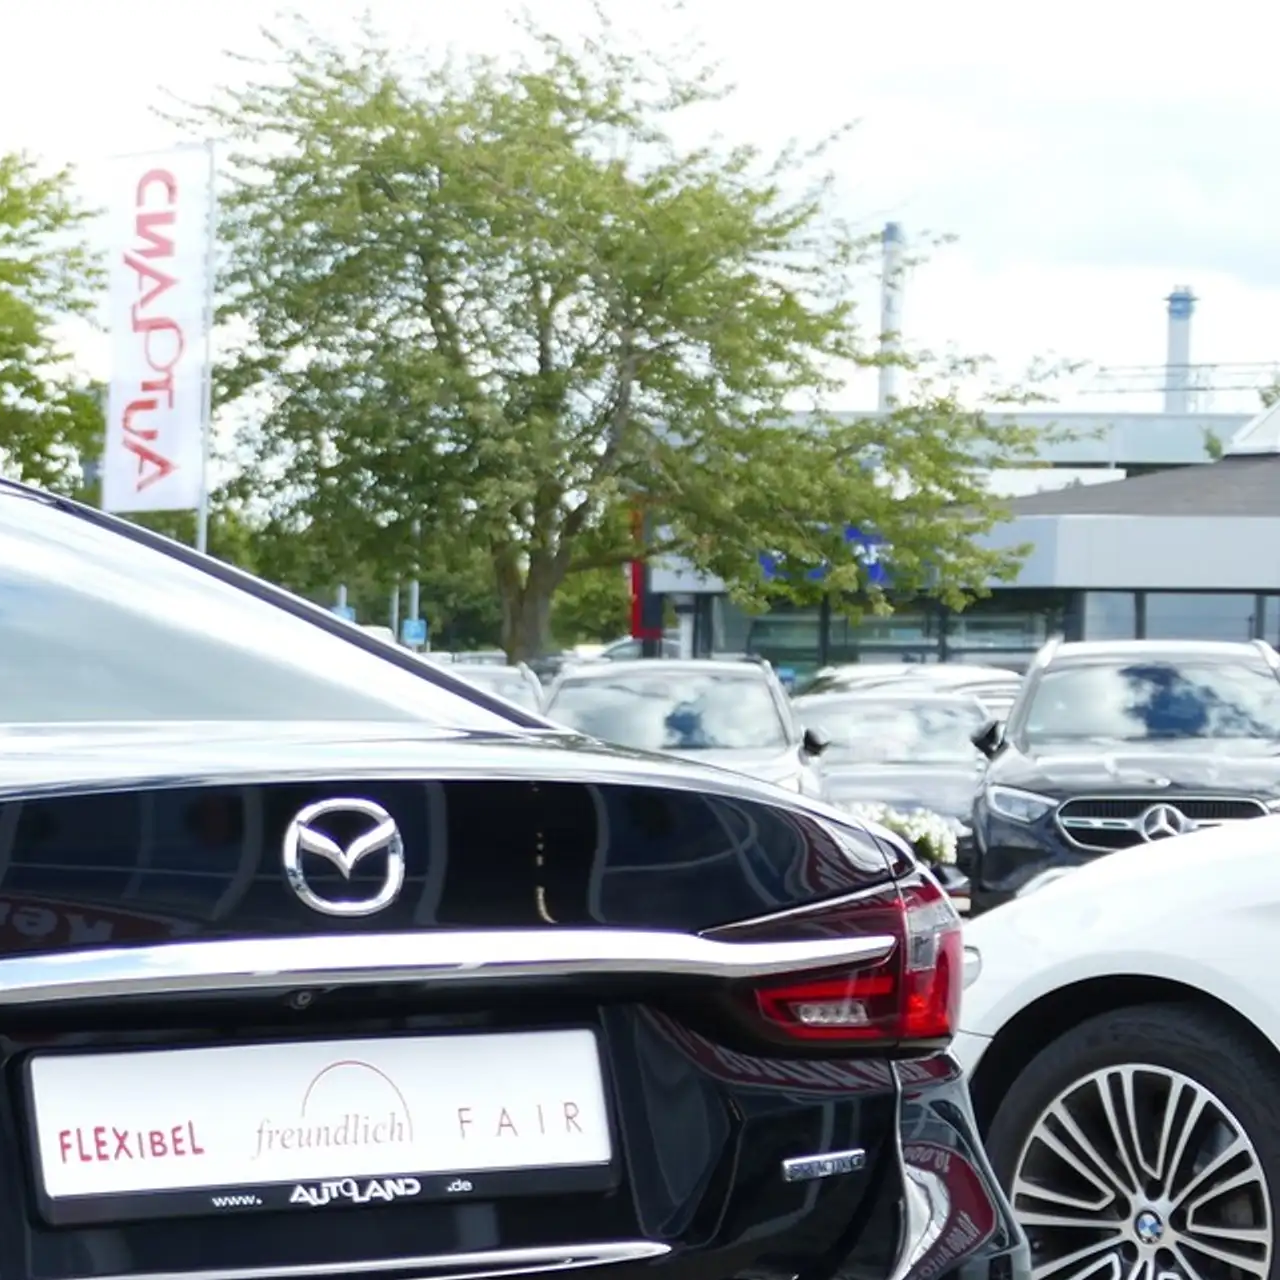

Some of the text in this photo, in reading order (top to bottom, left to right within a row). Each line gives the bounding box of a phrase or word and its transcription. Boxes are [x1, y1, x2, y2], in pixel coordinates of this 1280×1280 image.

[58, 1120, 205, 1164] FLEXIBEL
[250, 1111, 405, 1161] freundlich
[290, 1178, 422, 1206] AUTOLAND
